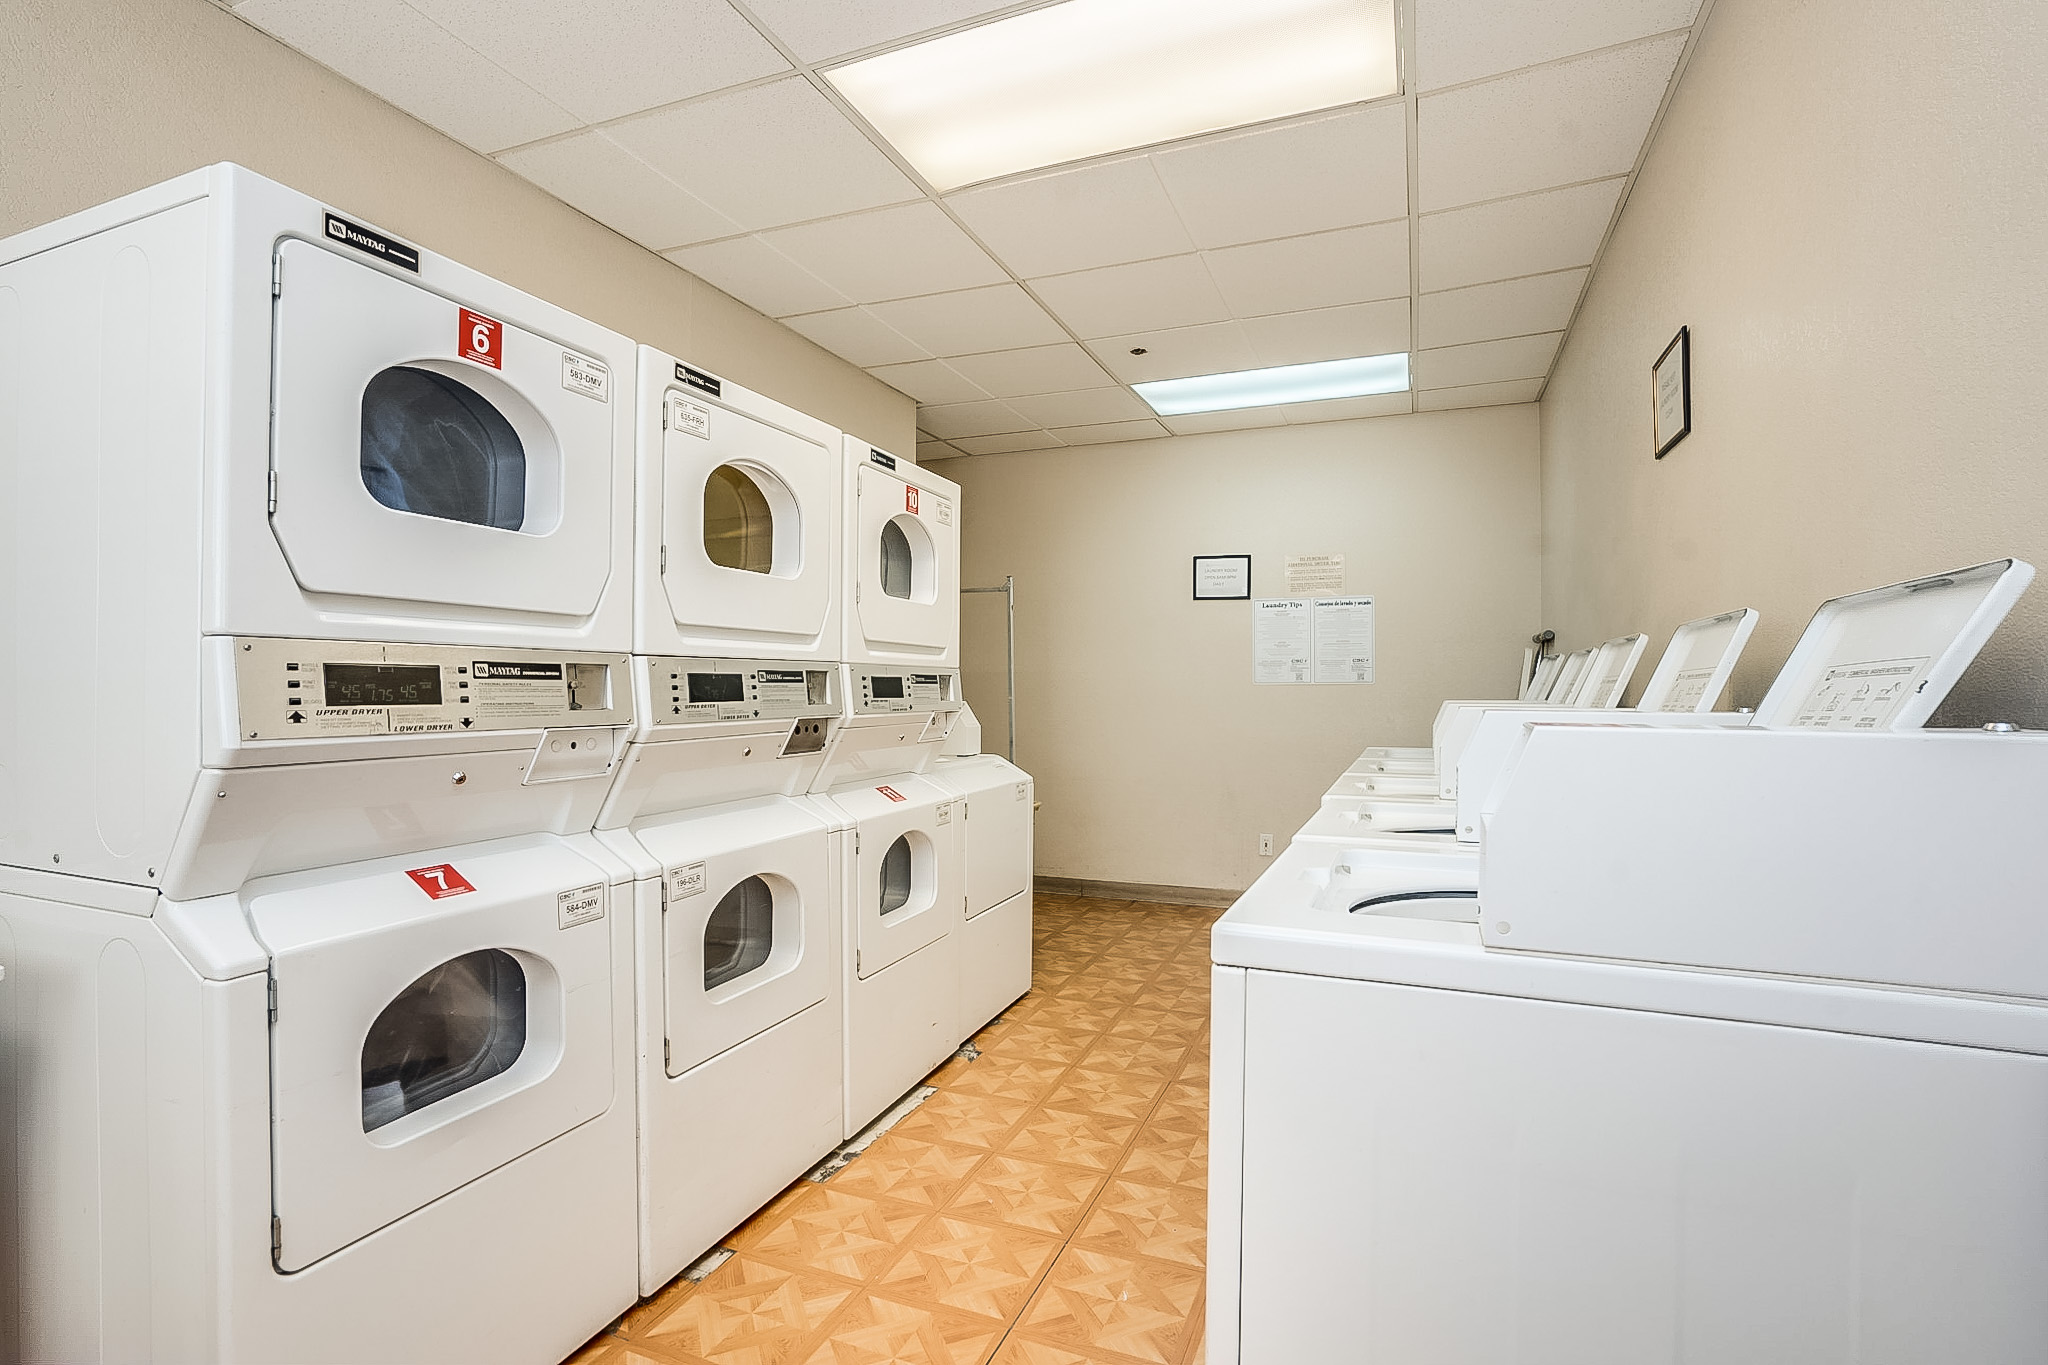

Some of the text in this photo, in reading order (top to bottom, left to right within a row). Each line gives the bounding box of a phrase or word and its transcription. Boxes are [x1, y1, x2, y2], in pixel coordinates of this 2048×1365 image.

[347, 230, 386, 253] MAYTAG
[472, 324, 490, 354] 6
[907, 491, 918, 509] 10
[489, 667, 521, 676] MAYTAG
[341, 684, 361, 699] 45
[371, 688, 394, 702] 1.75
[401, 685, 417, 699] 45
[424, 871, 449, 890] 7
